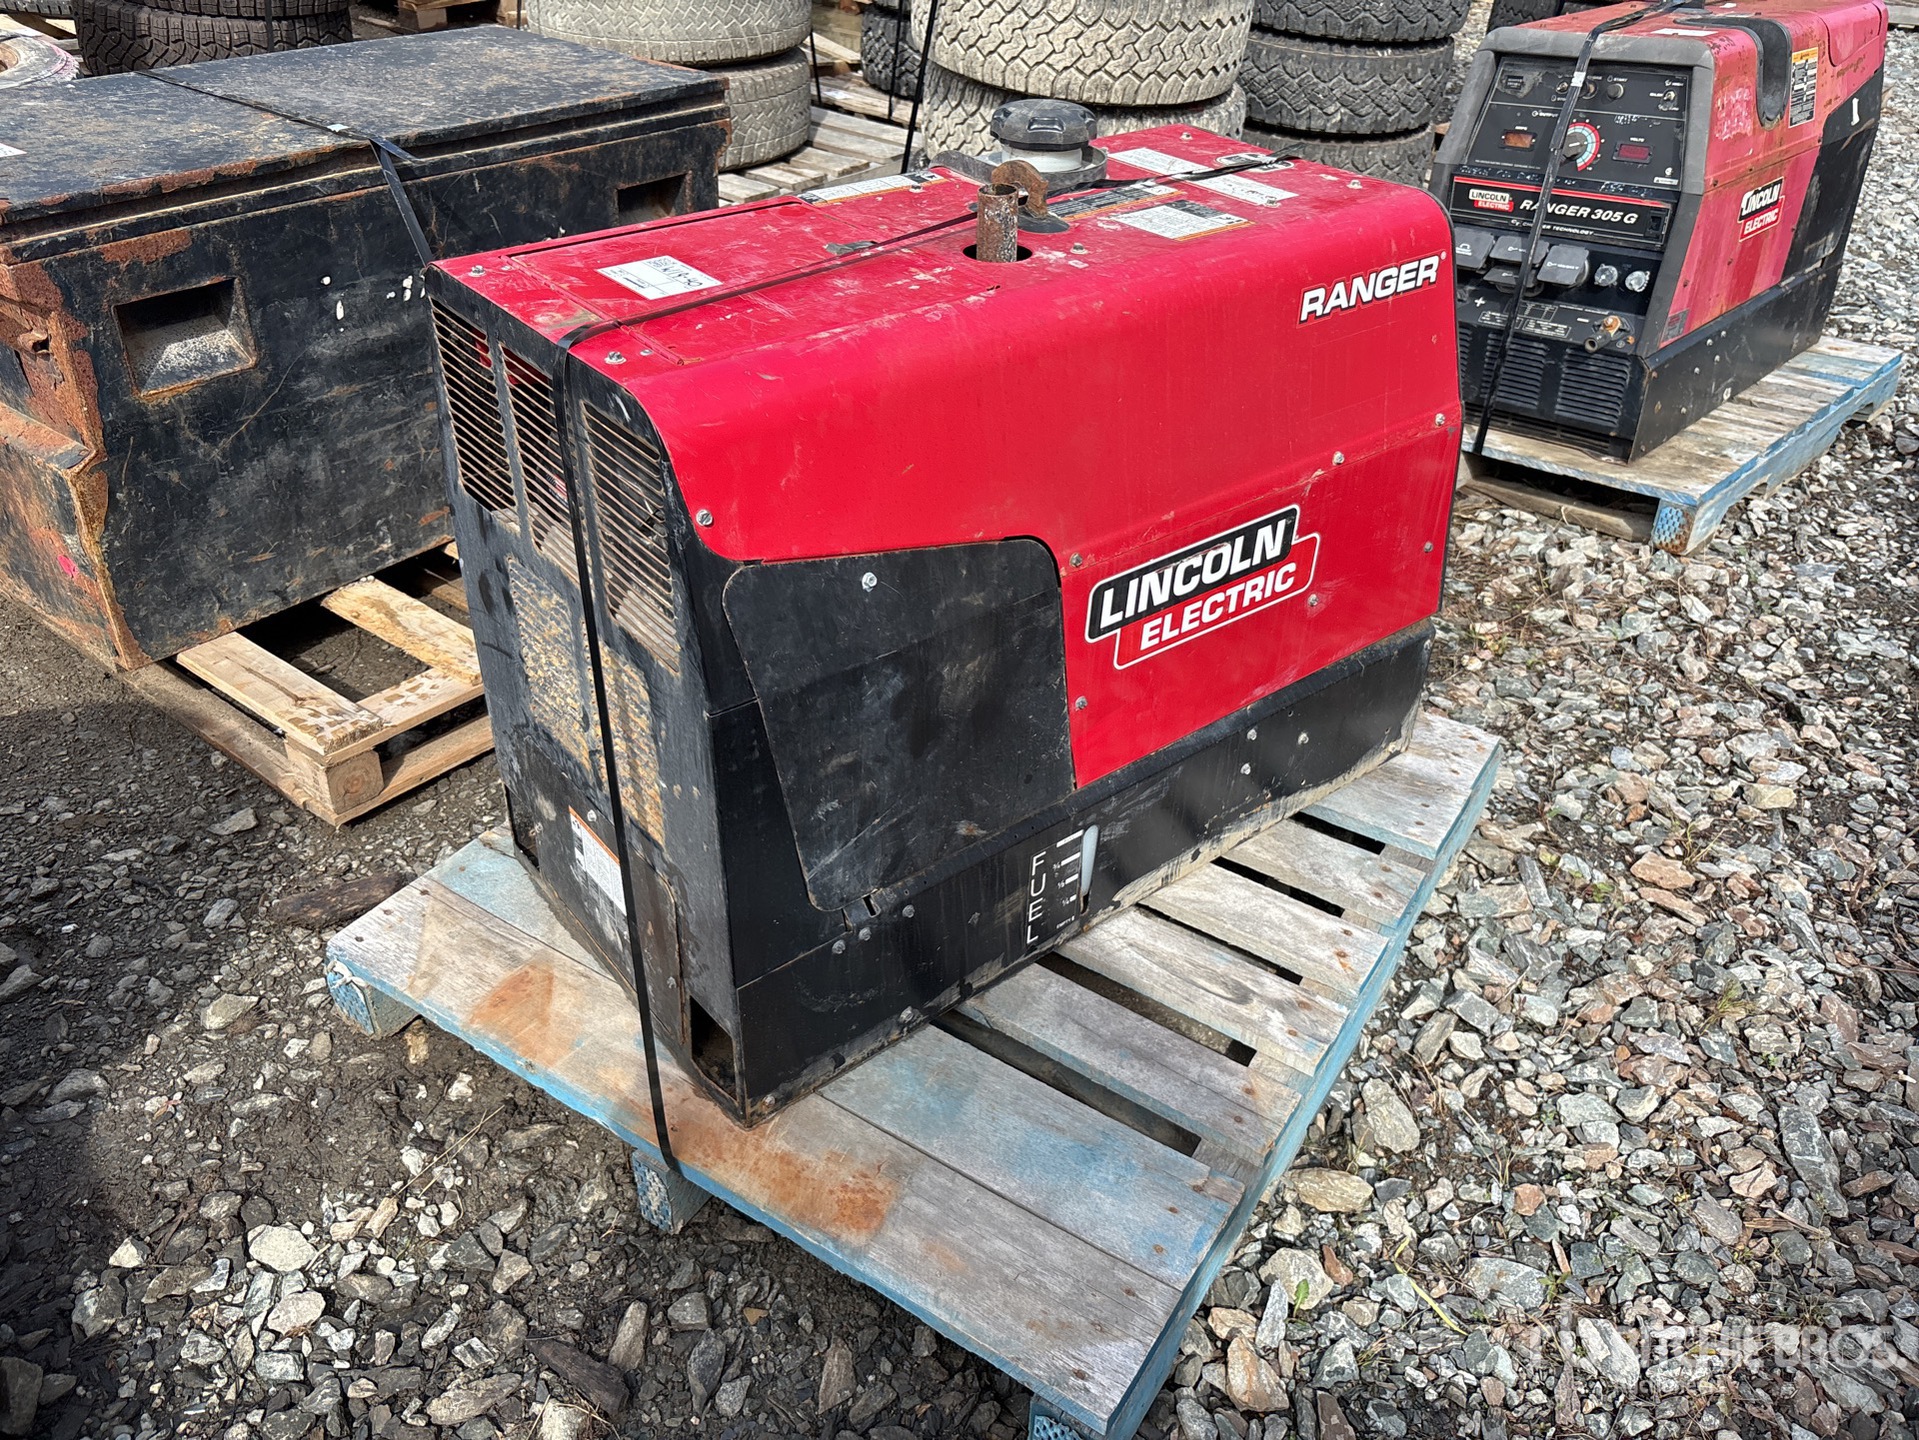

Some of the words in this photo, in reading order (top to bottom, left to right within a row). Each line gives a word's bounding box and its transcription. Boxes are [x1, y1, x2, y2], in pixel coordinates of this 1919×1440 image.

[1470, 191, 1508, 203] LINCOLN
[1477, 200, 1511, 211] ELECTRIC
[1741, 183, 1781, 215] LINCOLN
[1591, 208, 1624, 222] 305
[1743, 207, 1780, 235] ELECTRIC
[1300, 255, 1440, 322] RANGER
[1100, 518, 1287, 629] LINCOLN
[1140, 562, 1297, 651] ELECTRIC
[1027, 851, 1047, 944] FUEL
